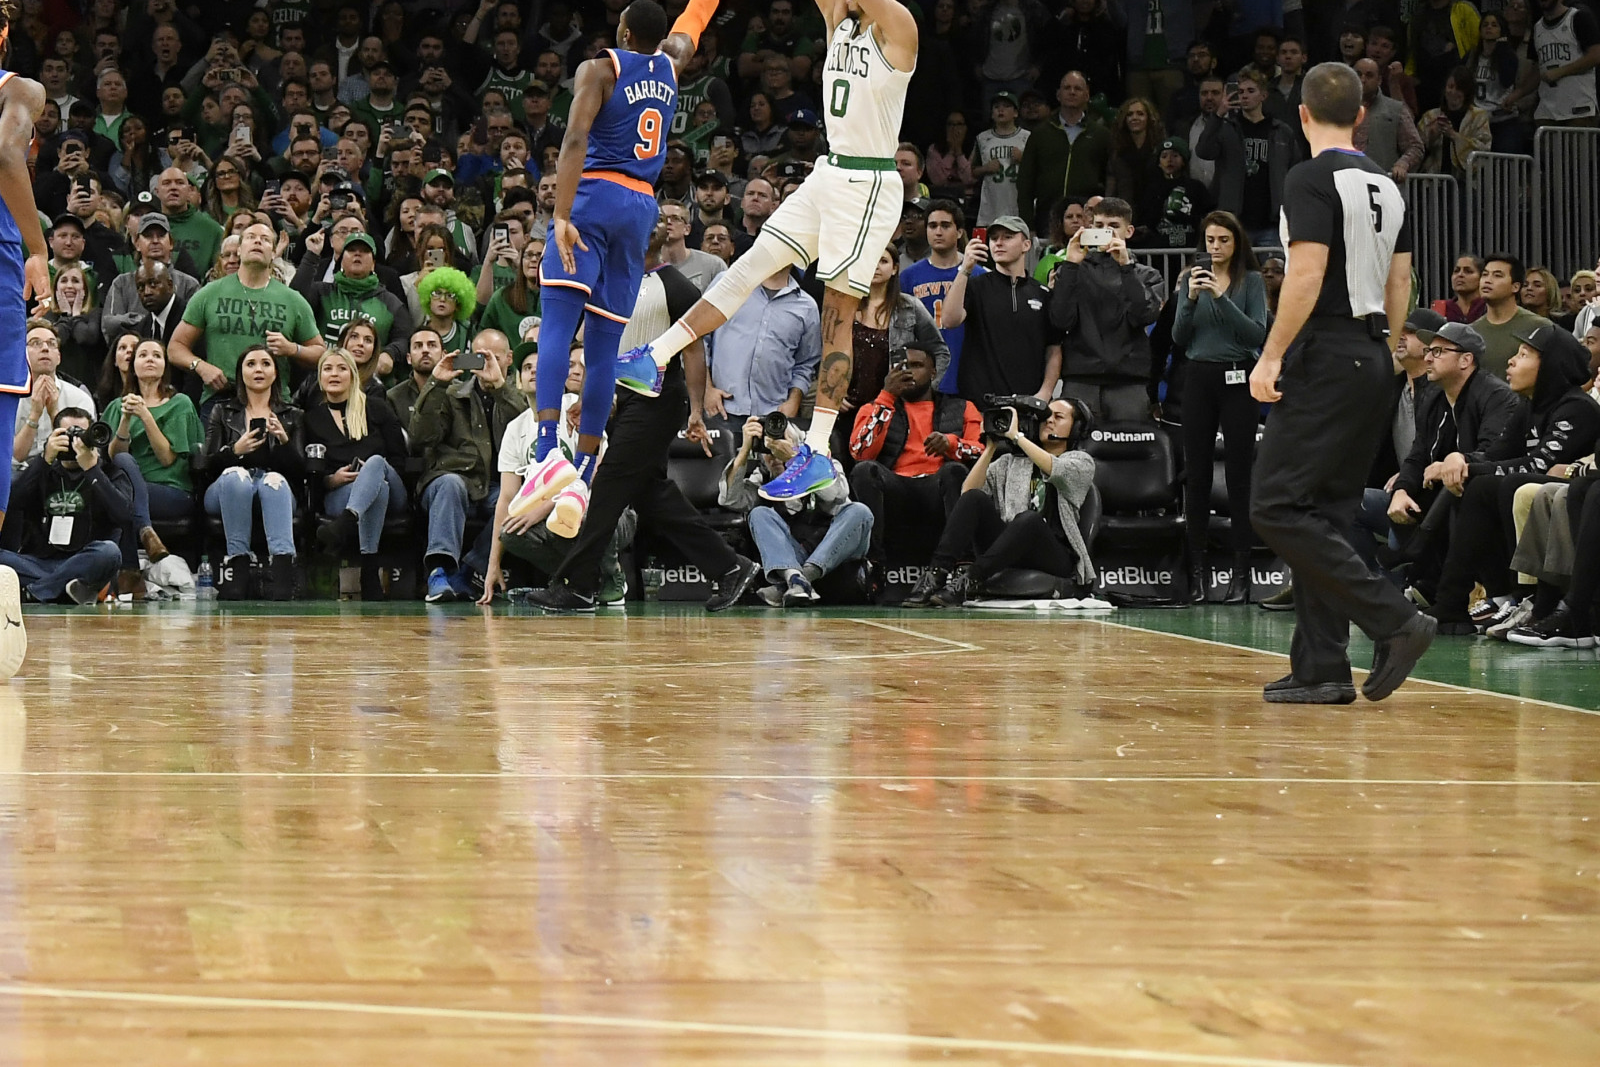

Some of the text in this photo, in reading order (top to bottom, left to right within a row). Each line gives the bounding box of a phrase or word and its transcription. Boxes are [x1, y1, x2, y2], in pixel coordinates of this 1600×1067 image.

[623, 80, 675, 106] BARRETT
[830, 79, 850, 118] 0
[633, 107, 663, 160] 9
[1366, 183, 1382, 233] 5
[912, 282, 940, 298] NEW
[216, 298, 287, 322] NOTRE
[217, 315, 285, 337] DAME
[1103, 431, 1155, 442] Putnam
[1099, 566, 1172, 588] jetBlue
